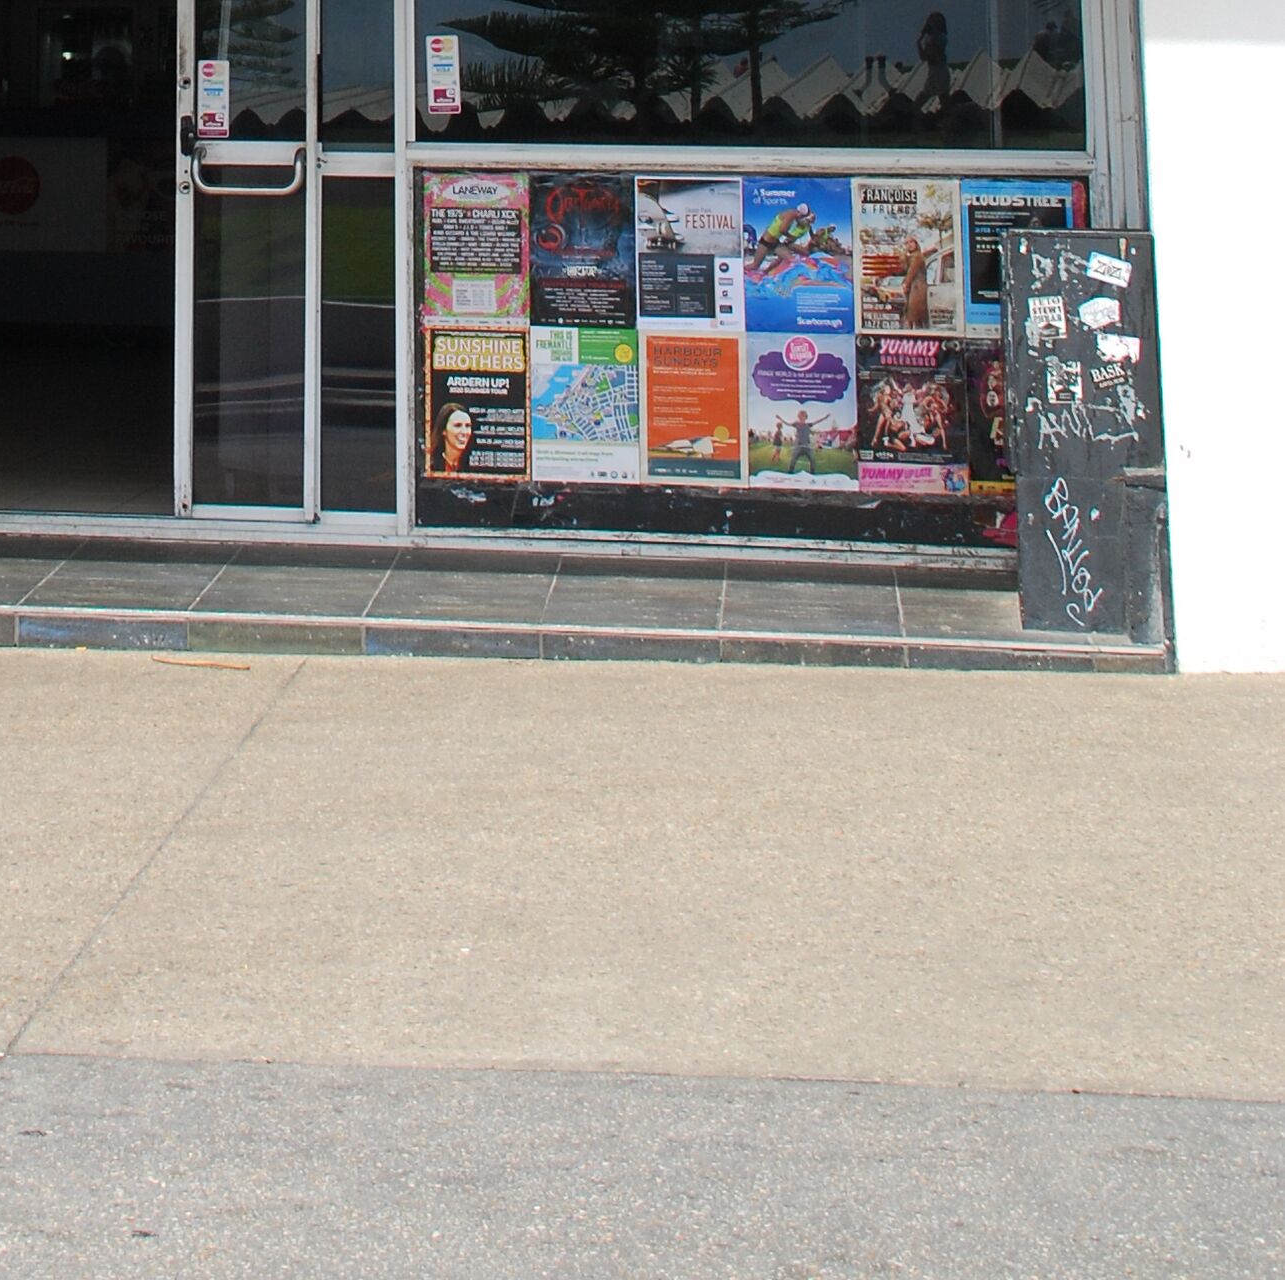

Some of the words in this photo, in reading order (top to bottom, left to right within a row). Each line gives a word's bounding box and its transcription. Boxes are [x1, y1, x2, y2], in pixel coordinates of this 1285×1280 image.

[452, 185, 498, 196] LANEWAY
[759, 188, 796, 198] Summer
[860, 189, 918, 204] FRANÇOISE
[752, 197, 762, 205] of
[872, 204, 918, 216] FRIENDS
[684, 214, 736, 230] FESTIVAL
[435, 338, 522, 355] SUNSHINE
[653, 346, 723, 357] HARBOUR
[878, 337, 940, 356] YUMMY
[434, 353, 525, 370] BROTHERS
[653, 356, 719, 368] SUNDAYS
[880, 354, 937, 367] UNLEASHED
[447, 376, 490, 388] ARDERN
[490, 377, 510, 389] UP!
[861, 468, 904, 480] YUMMY
